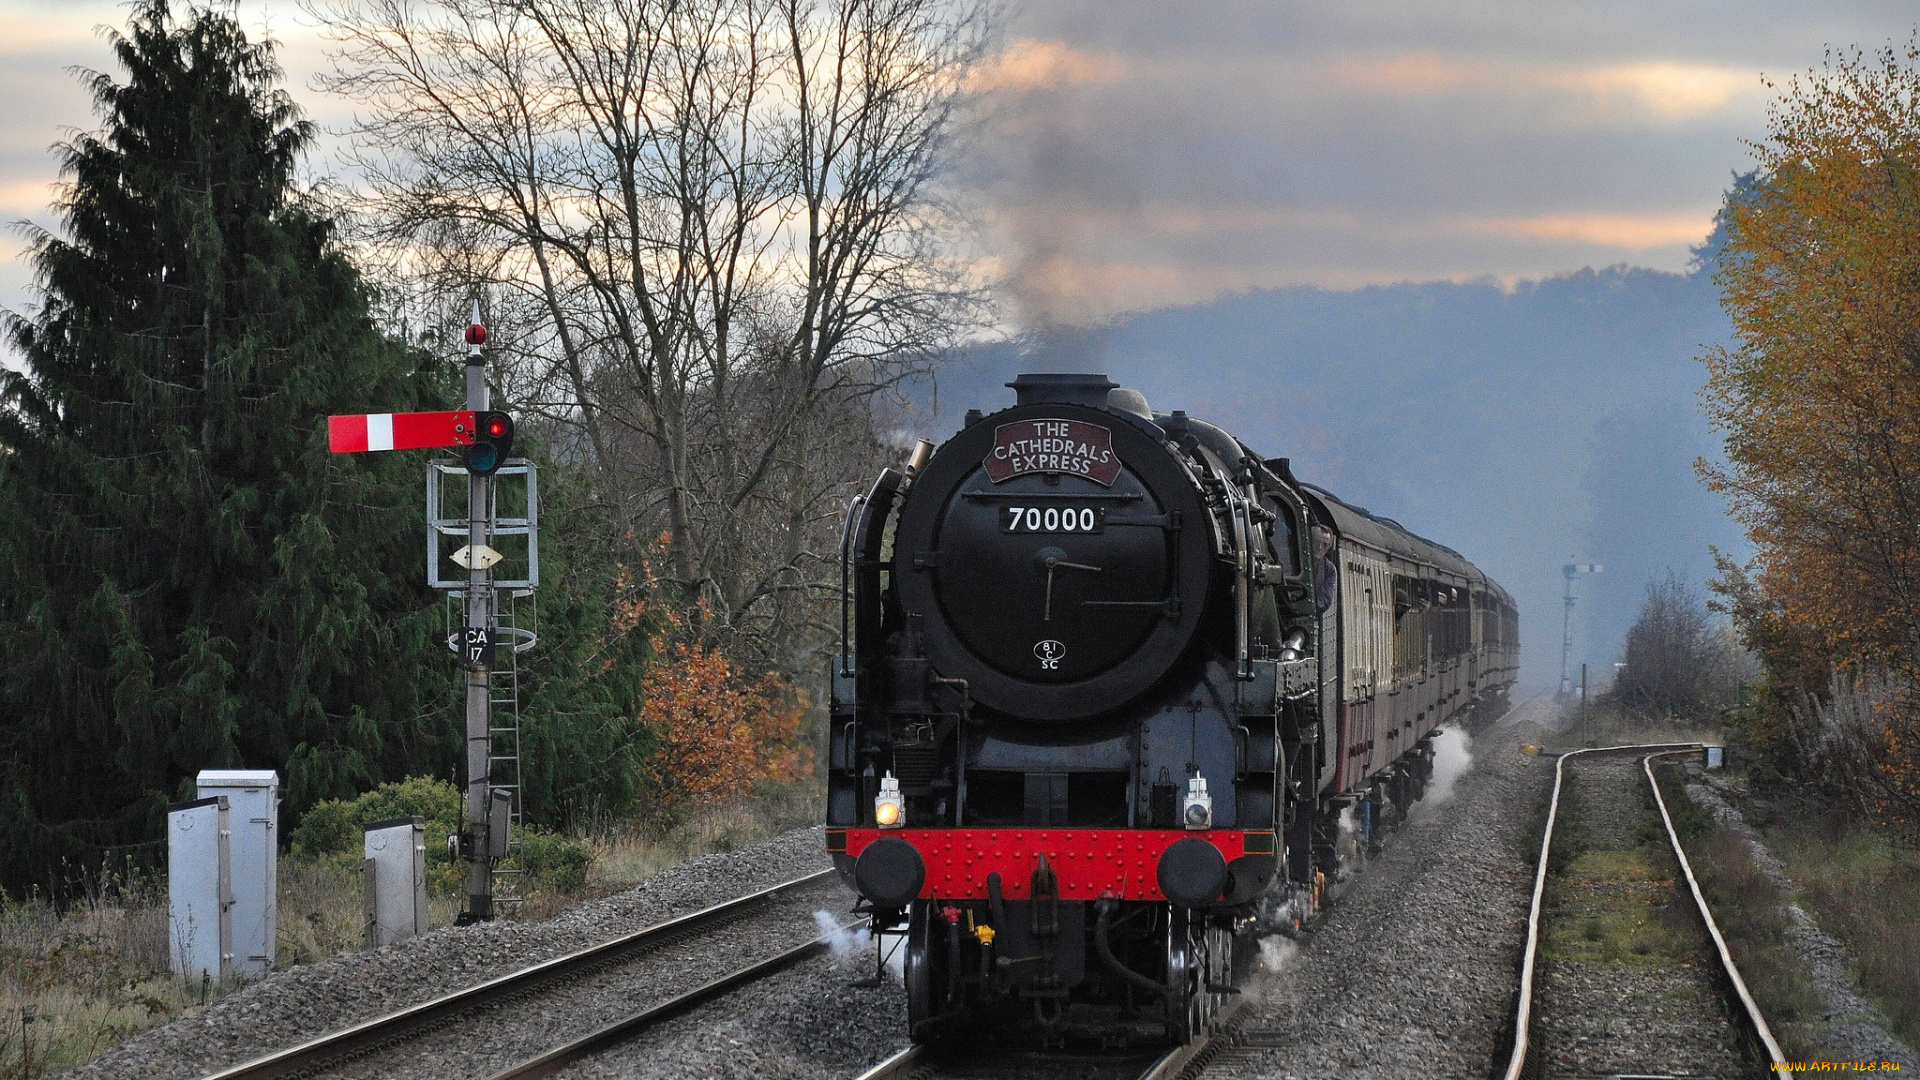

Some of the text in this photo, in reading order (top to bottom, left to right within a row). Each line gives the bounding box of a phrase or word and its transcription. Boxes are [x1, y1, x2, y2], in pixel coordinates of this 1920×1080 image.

[1033, 422, 1069, 437] THE
[994, 438, 1111, 464] CATHEDRALS
[1012, 454, 1091, 474] EXPRESS
[1009, 507, 1094, 531] 70000
[465, 630, 488, 644] CA
[470, 647, 483, 660] 17
[1046, 651, 1053, 659] C
[1041, 660, 1059, 669] SC
